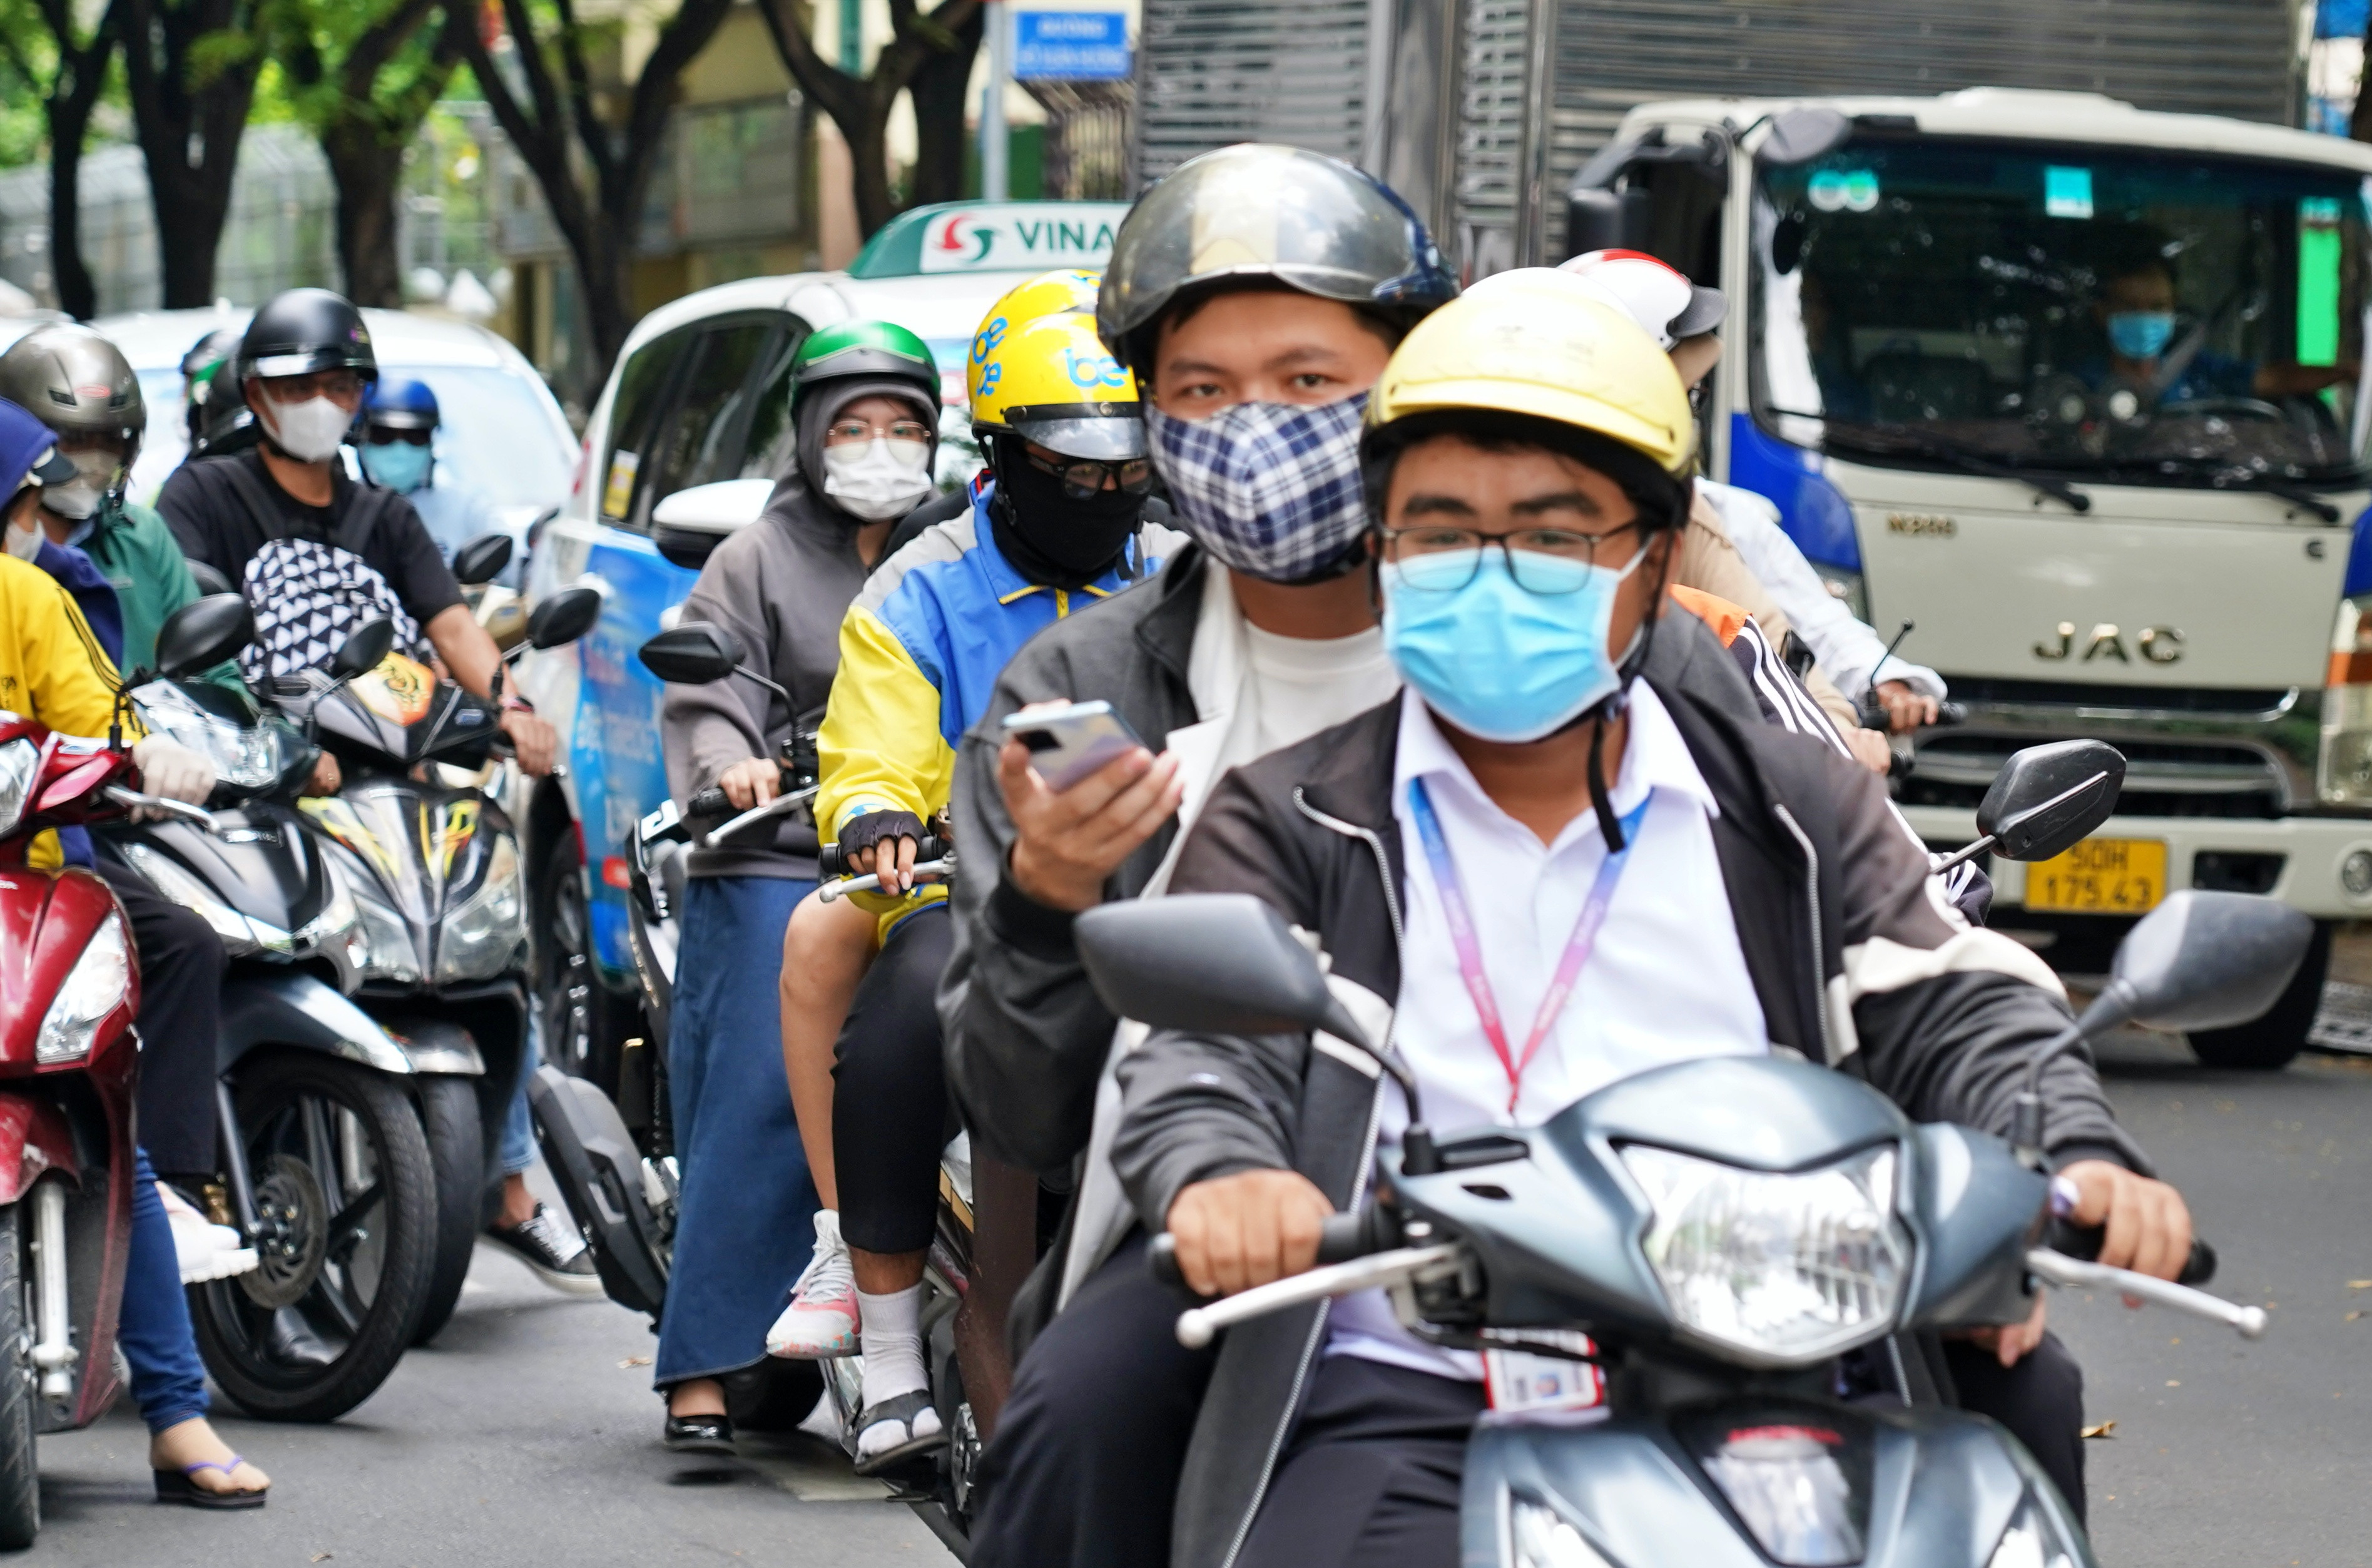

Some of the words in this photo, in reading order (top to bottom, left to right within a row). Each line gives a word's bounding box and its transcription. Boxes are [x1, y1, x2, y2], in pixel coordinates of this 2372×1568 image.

[1015, 221, 1115, 250] VINA
[1065, 348, 1129, 388] be
[2032, 621, 2186, 663] JAC
